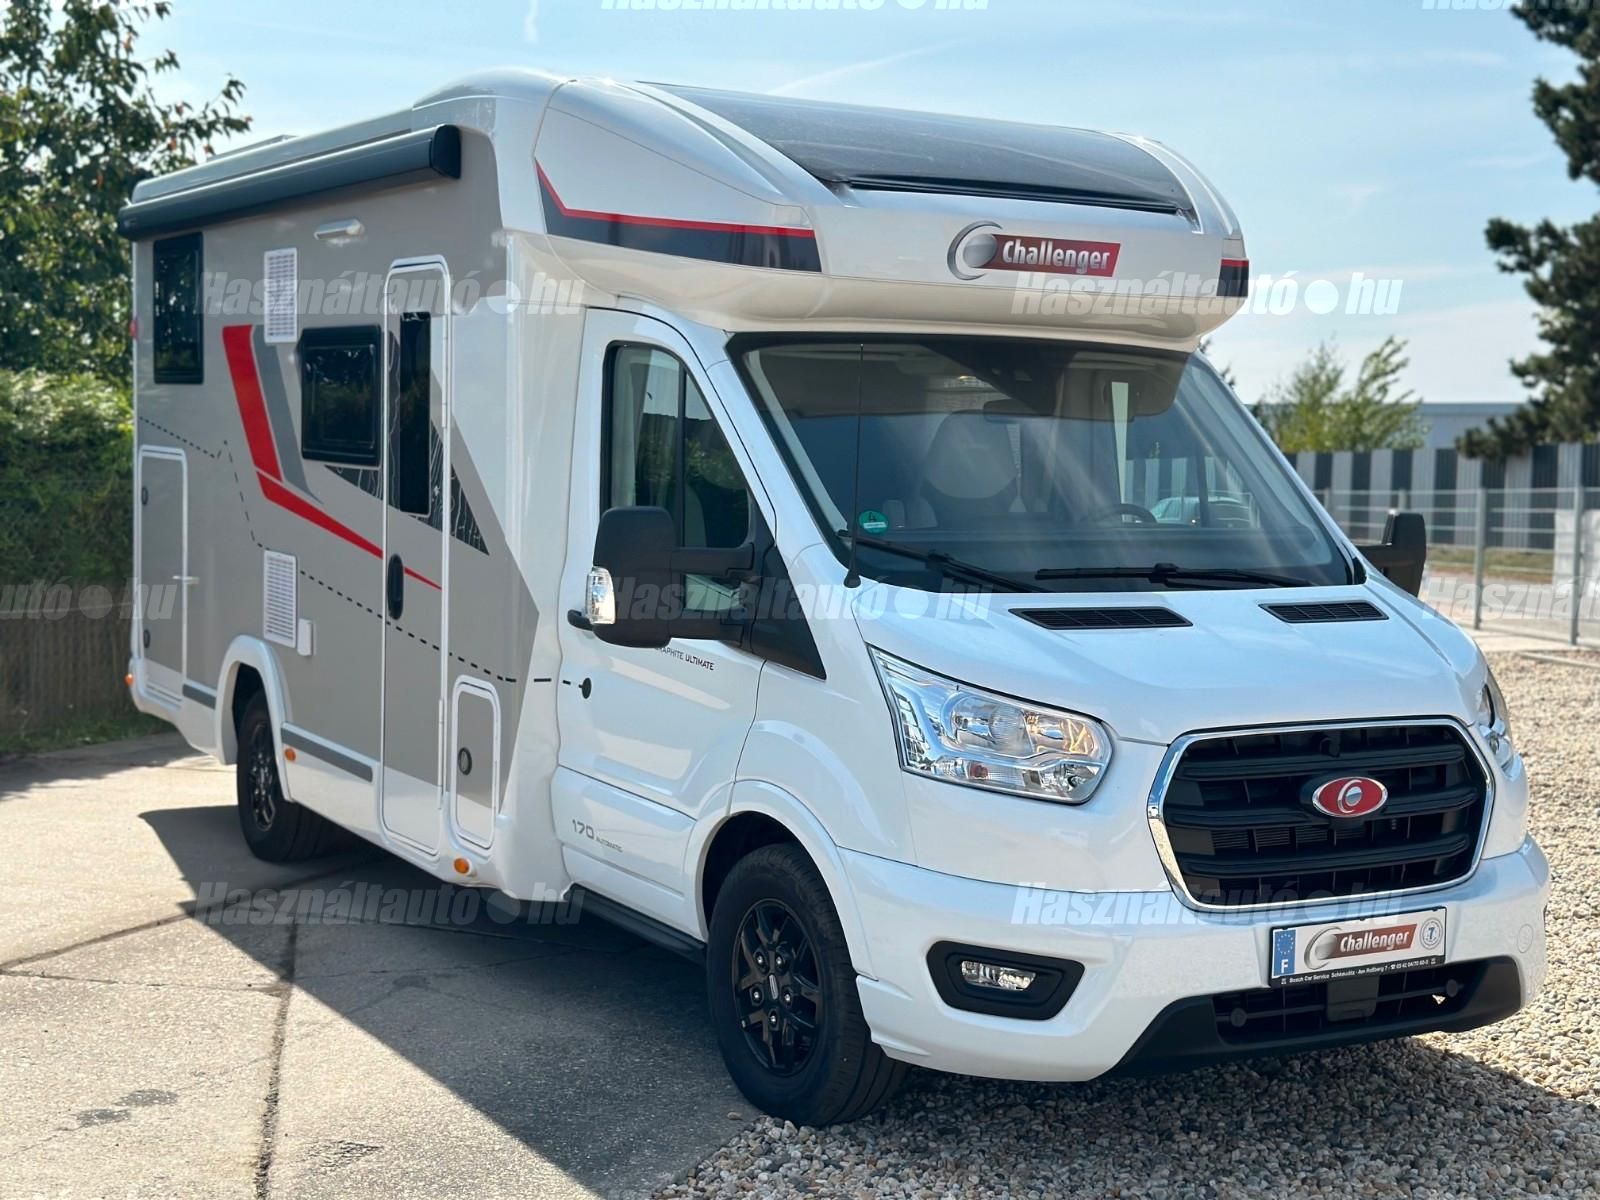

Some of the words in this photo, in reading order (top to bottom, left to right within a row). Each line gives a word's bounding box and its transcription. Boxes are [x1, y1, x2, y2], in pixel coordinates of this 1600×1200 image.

[1002, 238, 1111, 275] Challenger
[685, 654, 715, 671] ULTIMATE
[572, 819, 595, 840] 170
[1340, 931, 1410, 952] Challenger
[1281, 959, 1289, 973] F
